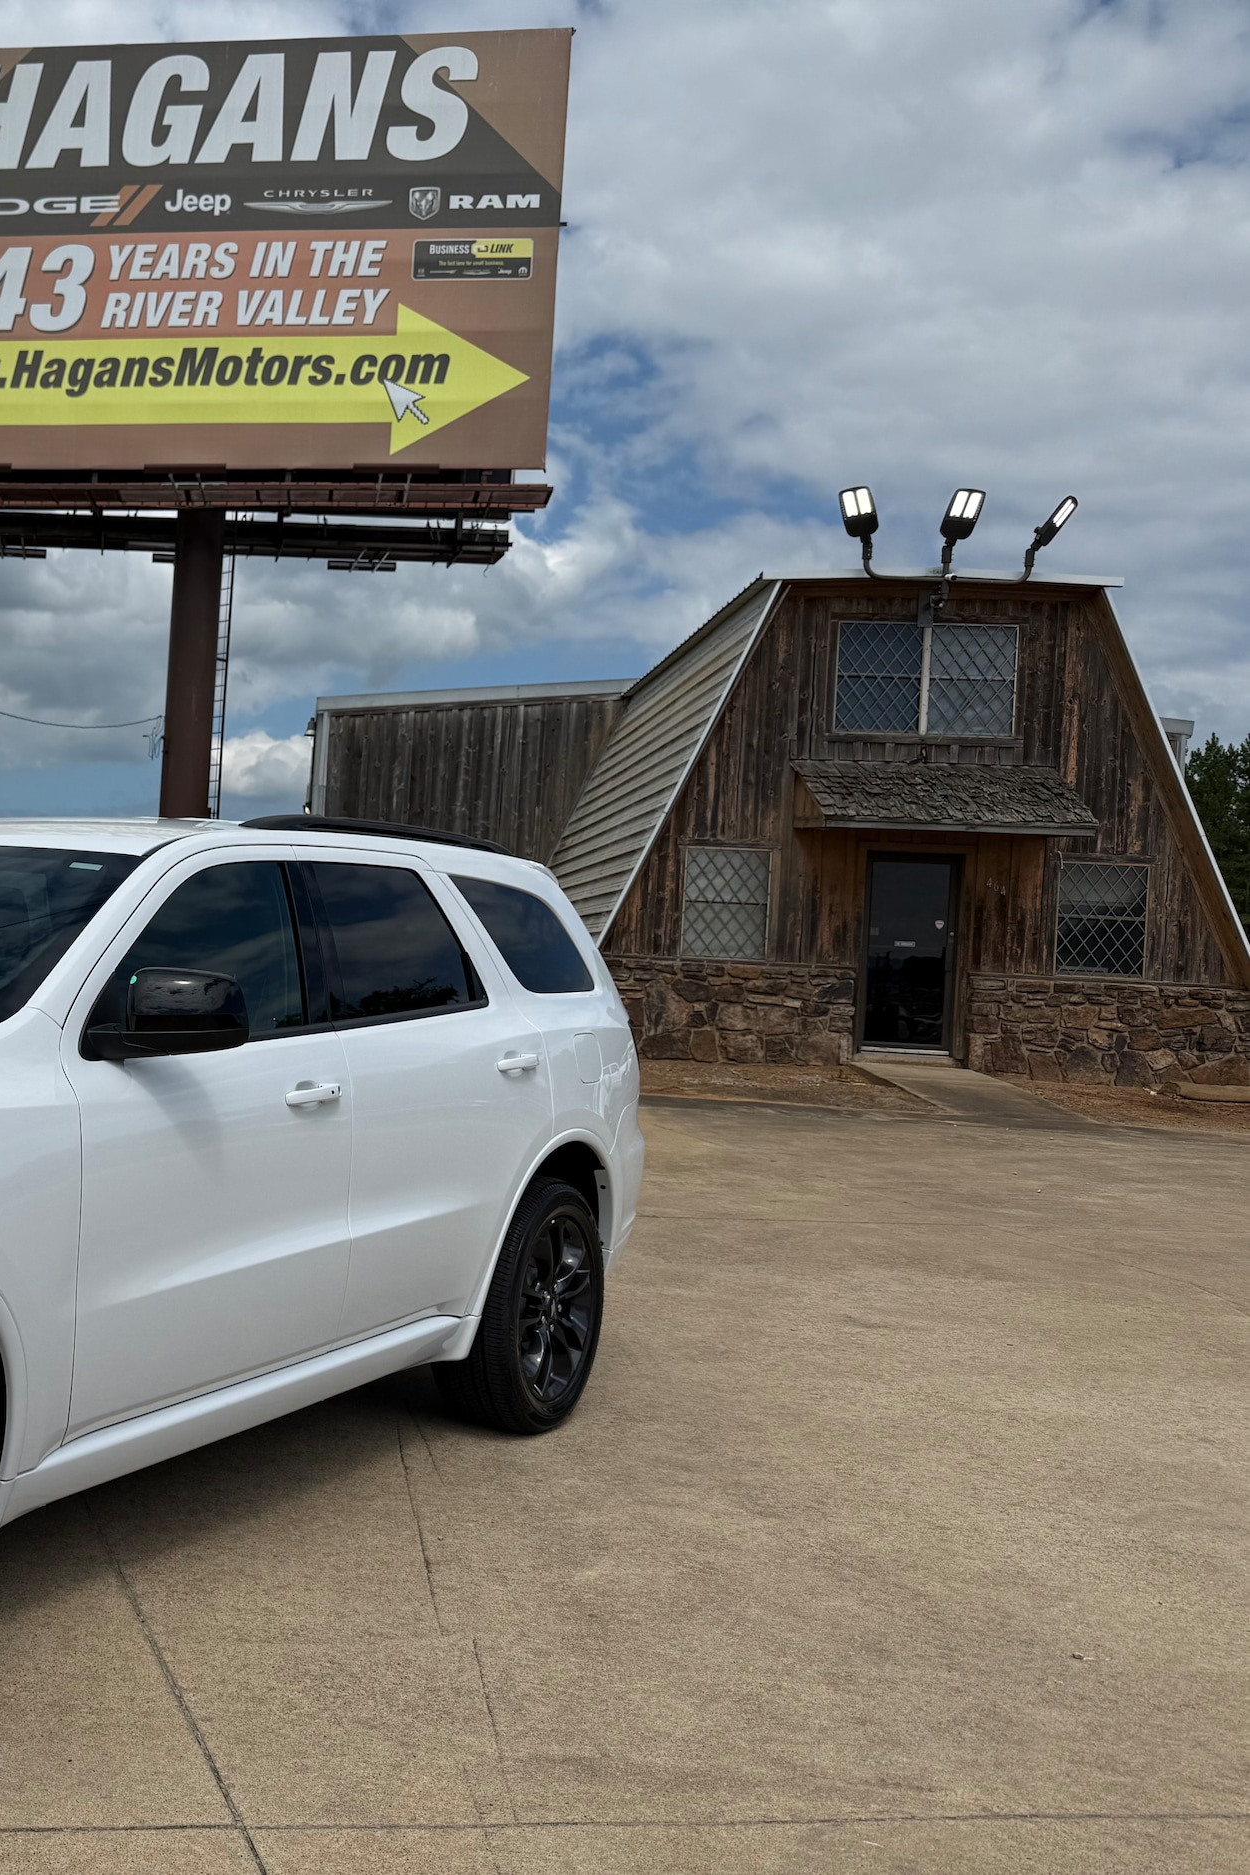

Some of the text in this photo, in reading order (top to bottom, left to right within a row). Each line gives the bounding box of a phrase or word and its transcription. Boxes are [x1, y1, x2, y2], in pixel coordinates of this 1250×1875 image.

[164, 189, 232, 216] Jeep
[263, 188, 373, 198] CHRYSLER
[448, 194, 541, 210] RAM
[429, 243, 514, 255] BUSINESS LINK
[108, 240, 388, 281] YEARS IN THE
[100, 289, 391, 329] RIVER VALLEY
